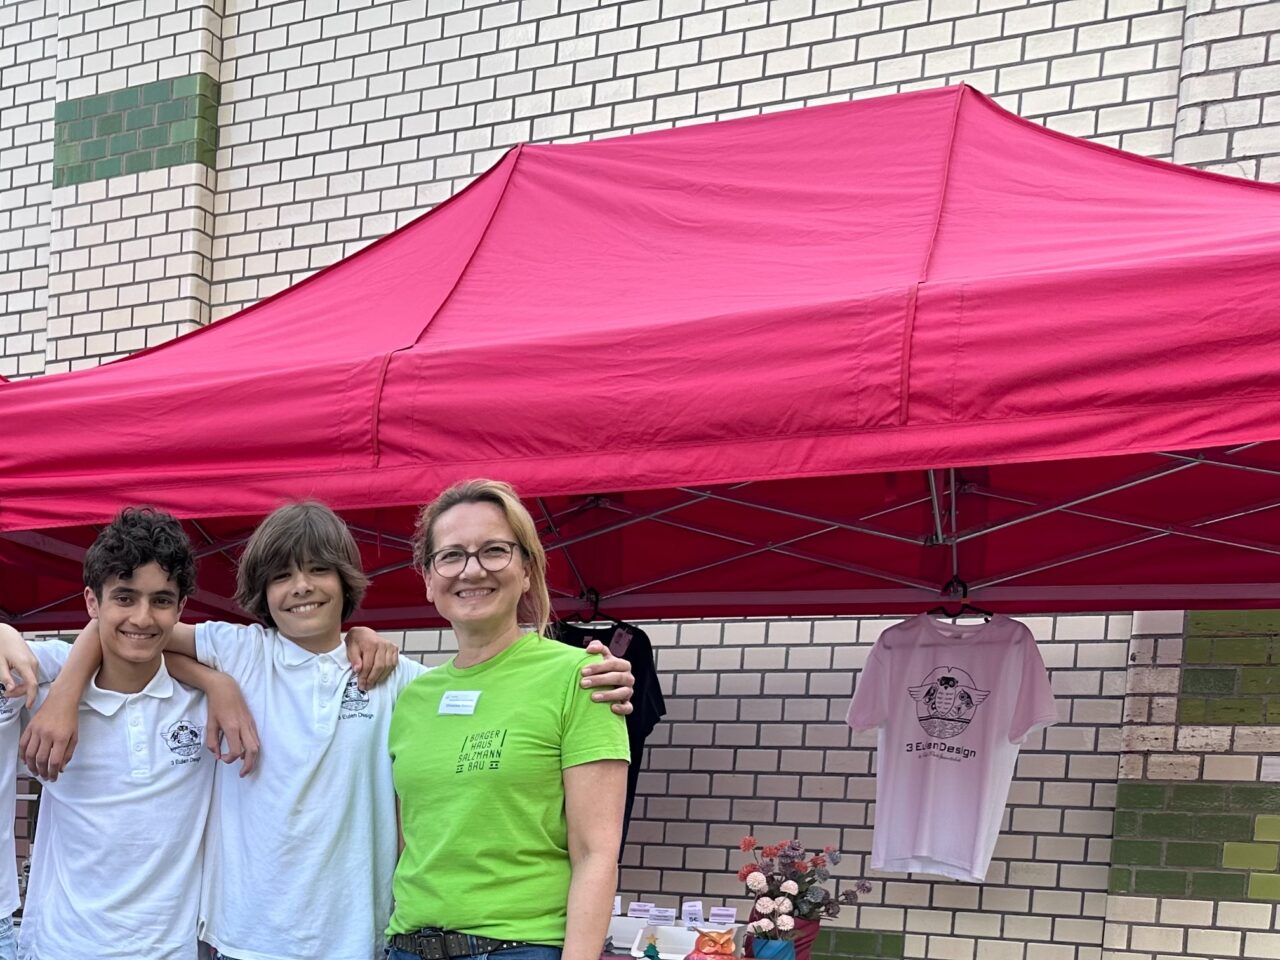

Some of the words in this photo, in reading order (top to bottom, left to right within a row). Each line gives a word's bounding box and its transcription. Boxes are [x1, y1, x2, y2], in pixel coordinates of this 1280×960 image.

[470, 740, 493, 751] HAUS
[906, 743, 914, 752] 3
[939, 742, 977, 759] Design
[458, 749, 502, 763] SALZMANN
[467, 761, 486, 772] BAU
